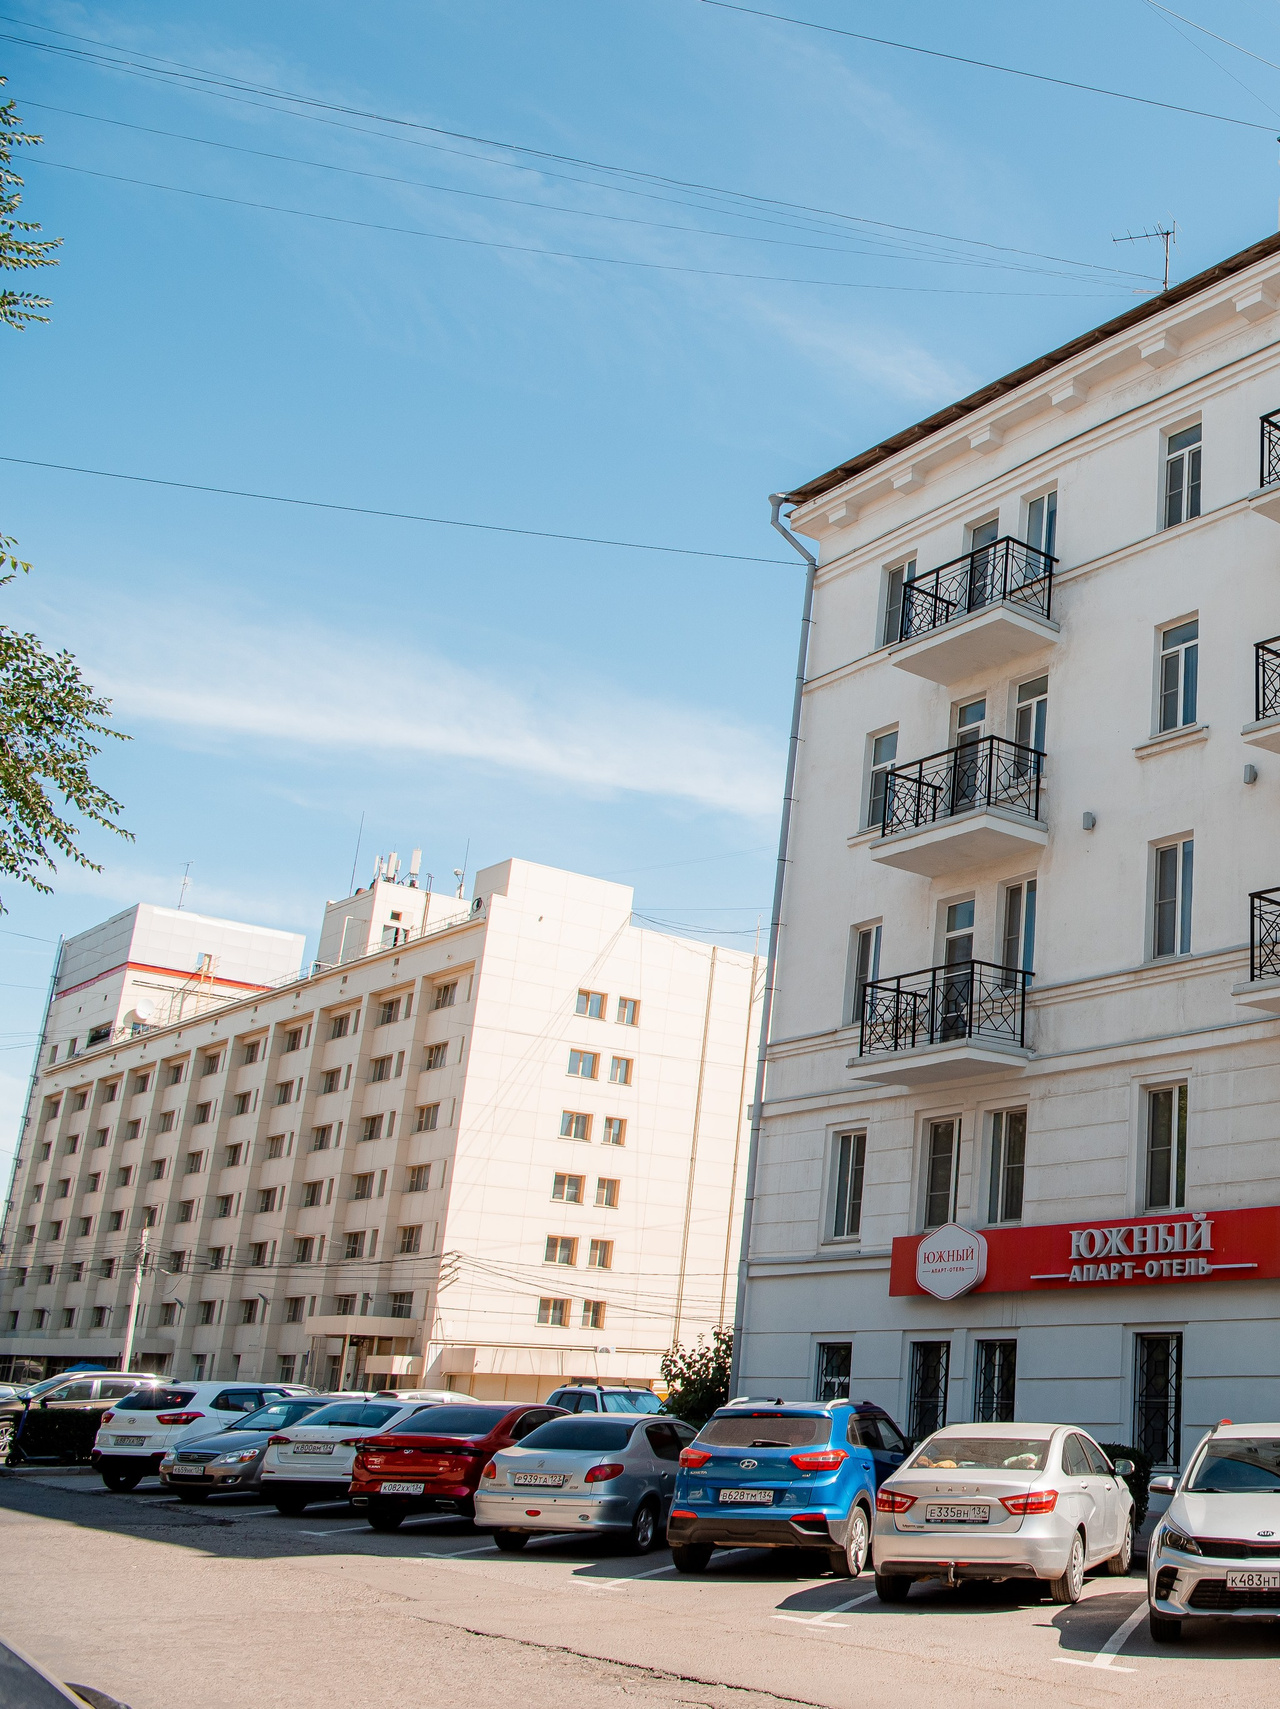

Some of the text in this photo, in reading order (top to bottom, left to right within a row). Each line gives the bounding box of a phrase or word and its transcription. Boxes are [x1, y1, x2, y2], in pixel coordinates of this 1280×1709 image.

[1068, 1212, 1215, 1260] ЮЖНЫЙ
[923, 1245, 975, 1265] ЮЖНЫЙ
[931, 1266, 966, 1274] АПАРТ-ОТЕЛЬ
[1068, 1257, 1213, 1282] АПАРТ-ОТЕЛЬ
[971, 1506, 987, 1515] 134
